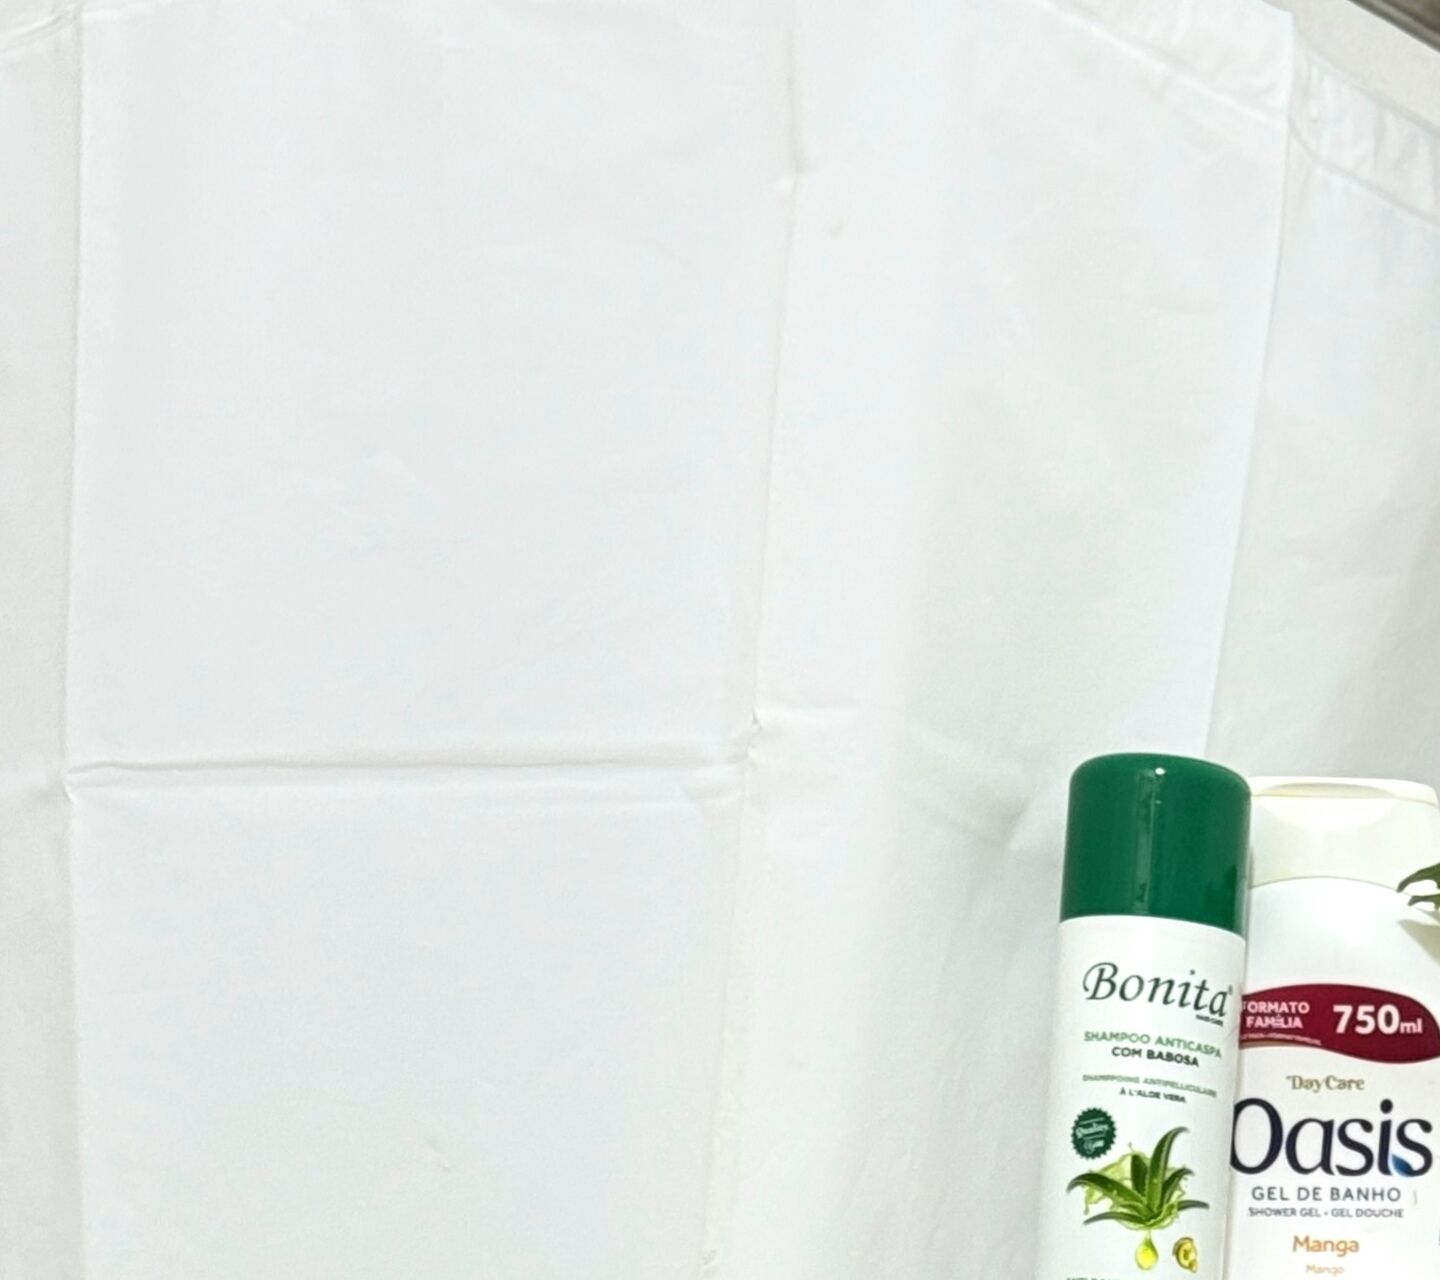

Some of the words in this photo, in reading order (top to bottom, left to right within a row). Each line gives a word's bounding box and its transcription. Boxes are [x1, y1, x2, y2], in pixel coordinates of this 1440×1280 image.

[1083, 962, 1227, 1017] Bonita
[1332, 1004, 1423, 1035] 750ml
[1084, 1031, 1151, 1044] SHAMPOO
[1155, 1036, 1221, 1058] ANTICASPA
[1111, 1046, 1142, 1057] COM
[1146, 1049, 1199, 1067] BABOSA
[1230, 1098, 1433, 1177] Oasis
[1251, 1186, 1290, 1202] GEL
[1297, 1187, 1322, 1201] DE
[1329, 1187, 1401, 1202] BANHO
[1248, 1207, 1297, 1217] SHOWER
[1300, 1207, 1321, 1217] GEL
[1331, 1208, 1351, 1217] GEL
[1355, 1208, 1404, 1218] DOUCHE
[1292, 1235, 1360, 1257] Manga
[1306, 1264, 1344, 1276] Mango
